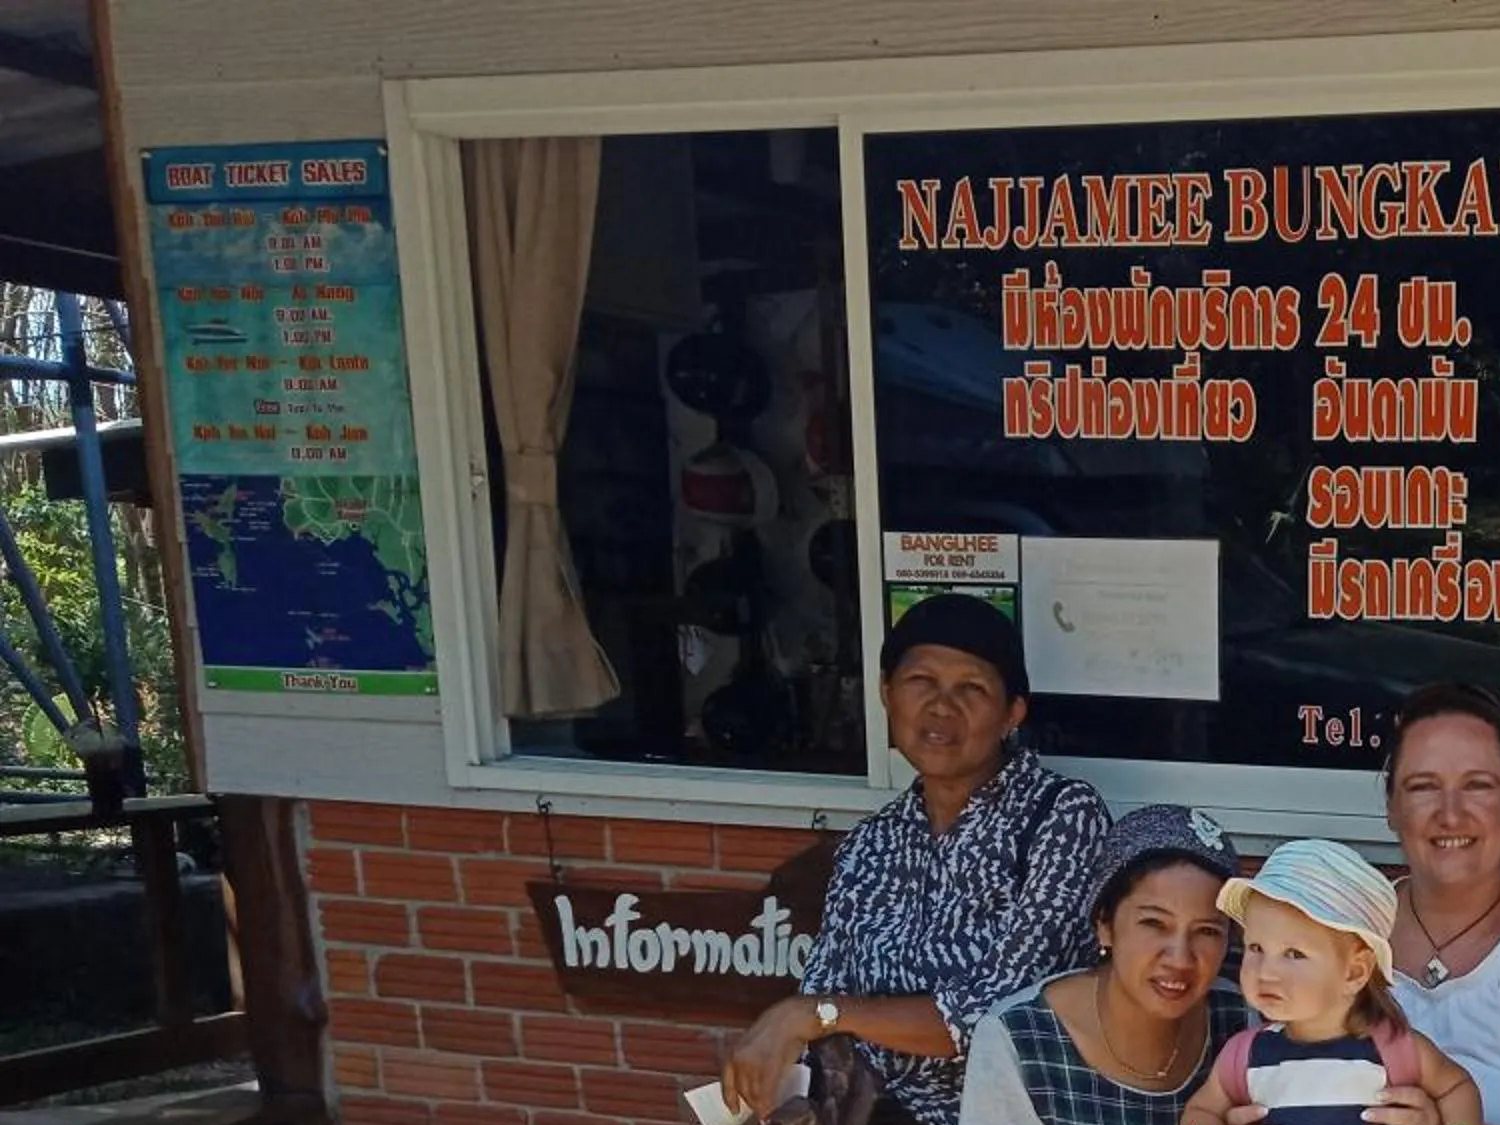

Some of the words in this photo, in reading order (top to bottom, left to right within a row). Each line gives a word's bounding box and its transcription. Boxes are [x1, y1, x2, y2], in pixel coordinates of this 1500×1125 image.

[167, 164, 213, 188] BOAT
[225, 162, 291, 186] TICKET
[303, 159, 366, 184] SALES
[897, 170, 1211, 250] NAJJAMEE
[1002, 261, 1301, 350] มีห้องพักบริการ
[1314, 272, 1380, 348] 24
[1397, 276, 1472, 348] ชม.
[1003, 351, 1257, 443] ทริปท่องเที่ยว
[1312, 355, 1479, 443] อันดามัน
[1307, 466, 1468, 528] รอบเกาะ
[924, 554, 945, 567] FOR
[948, 554, 976, 567] RENT
[1298, 706, 1381, 748] Tel.
